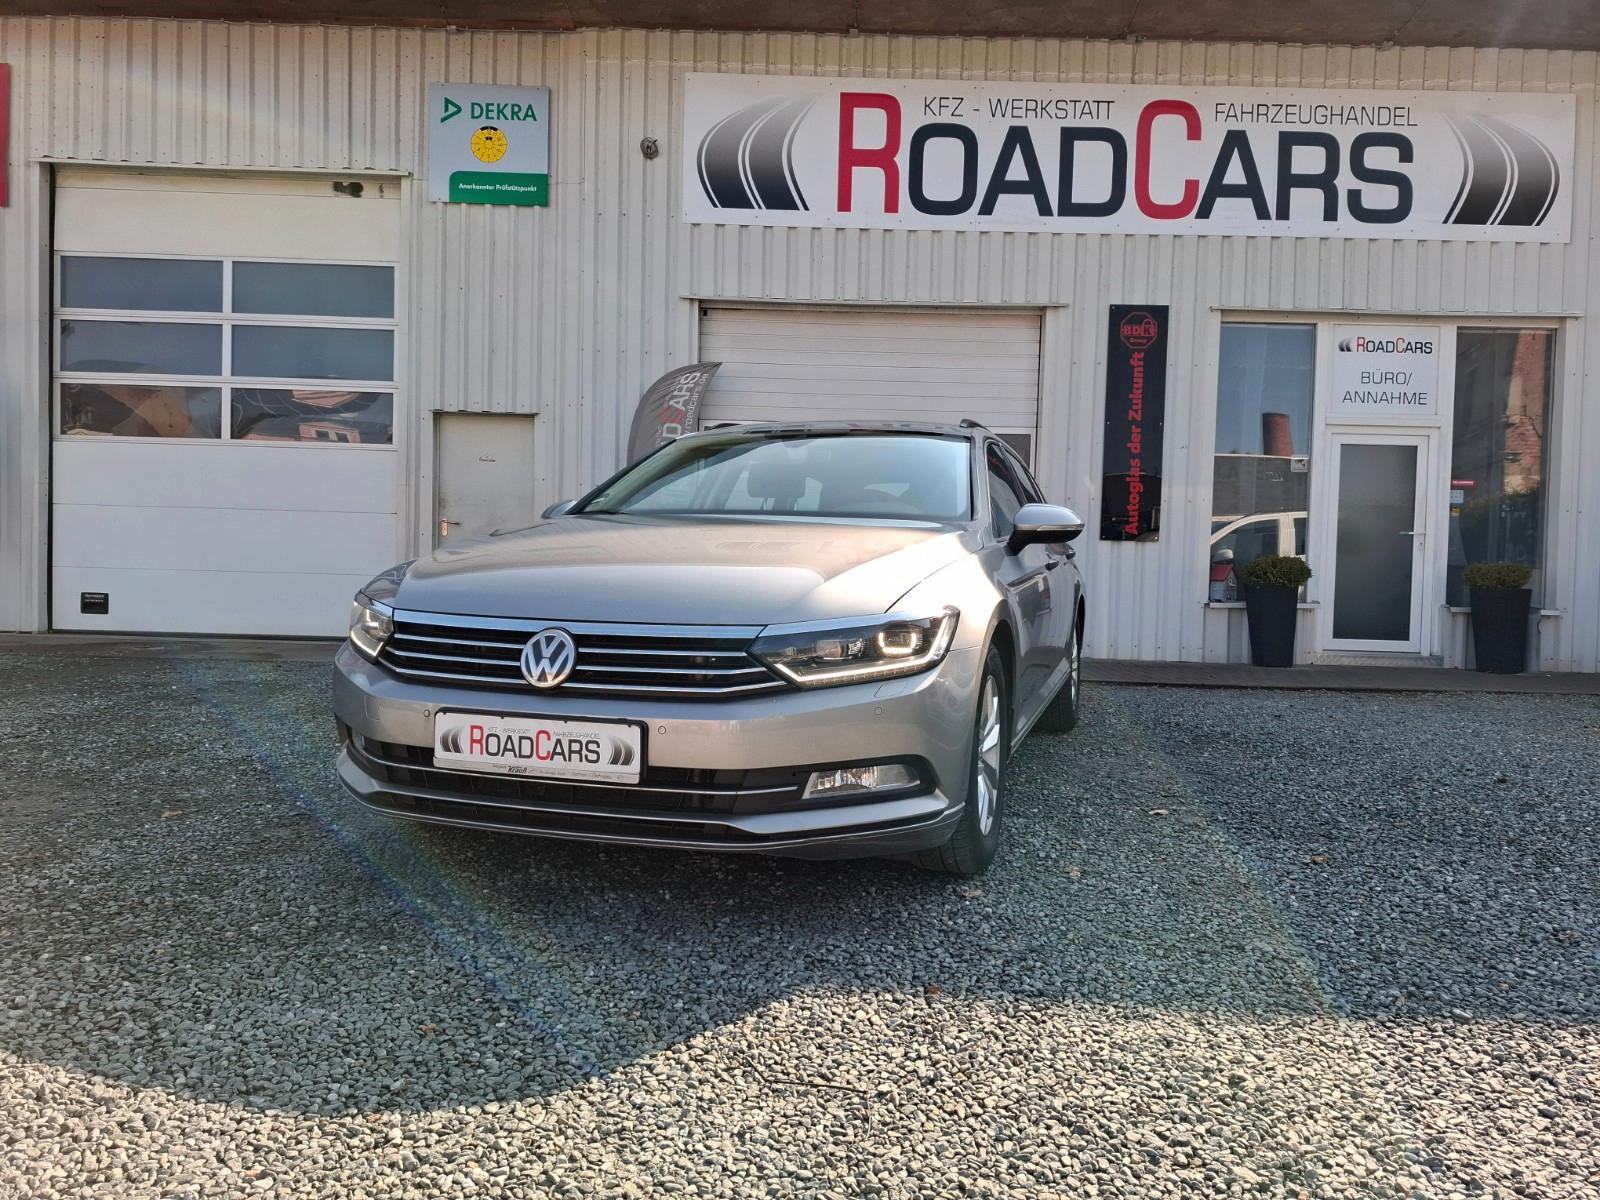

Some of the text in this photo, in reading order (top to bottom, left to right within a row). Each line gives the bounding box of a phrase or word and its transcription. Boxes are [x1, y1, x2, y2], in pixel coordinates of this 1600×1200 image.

[470, 102, 537, 121] DEKRA
[923, 97, 965, 117] KFZ
[988, 97, 1115, 120] WERKSTATT
[1215, 102, 1418, 126] FAHRZEUGHANDEL
[1361, 368, 1413, 386] BÜRO/
[1342, 390, 1428, 406] ANNAHME
[1124, 351, 1144, 536] Autoglas der Zukunft
